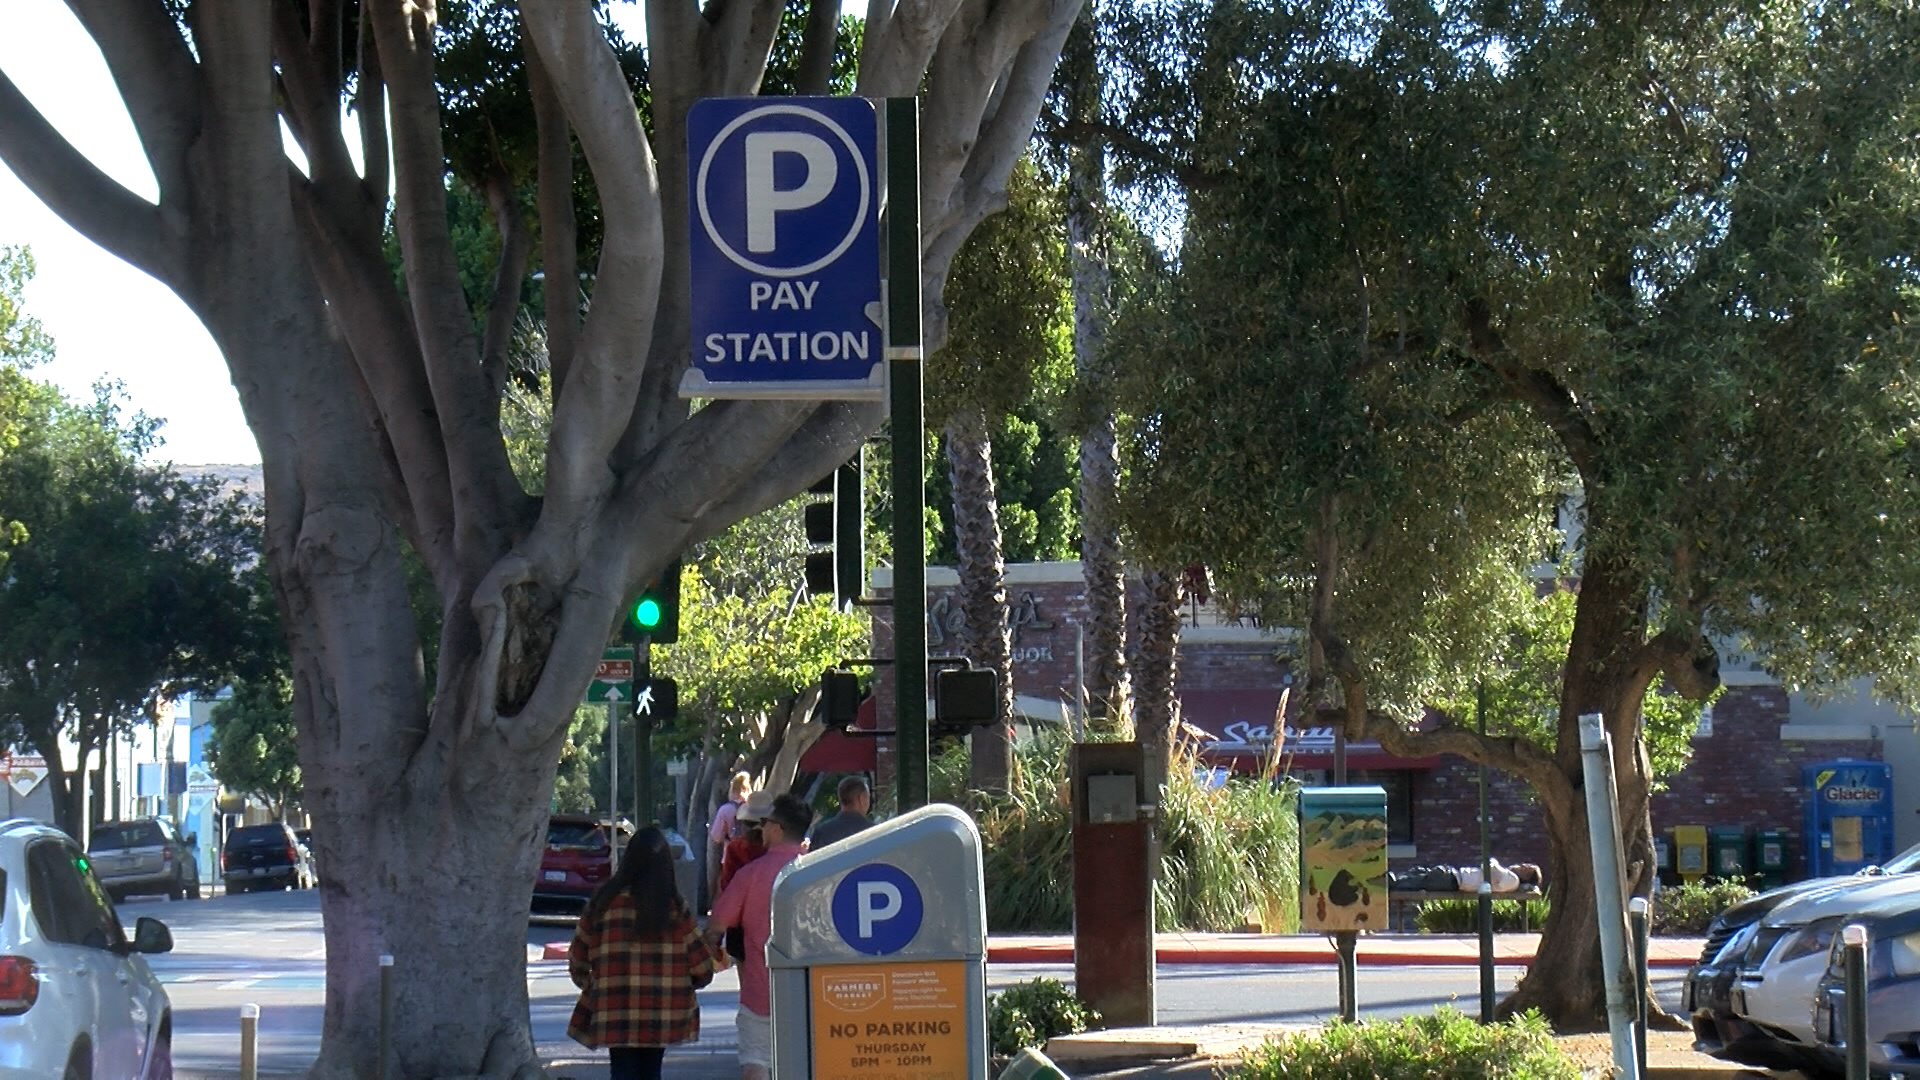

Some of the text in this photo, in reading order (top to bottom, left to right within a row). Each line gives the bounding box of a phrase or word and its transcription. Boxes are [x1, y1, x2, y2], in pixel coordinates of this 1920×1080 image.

[745, 131, 838, 253] P
[750, 281, 820, 311] PAY
[705, 330, 869, 363] STATION
[1826, 786, 1881, 801] Glacier
[857, 881, 903, 939] P
[829, 1020, 951, 1038] NO PARKING
[855, 1043, 927, 1055] THURSDAY
[896, 1055, 932, 1067] 10PM
